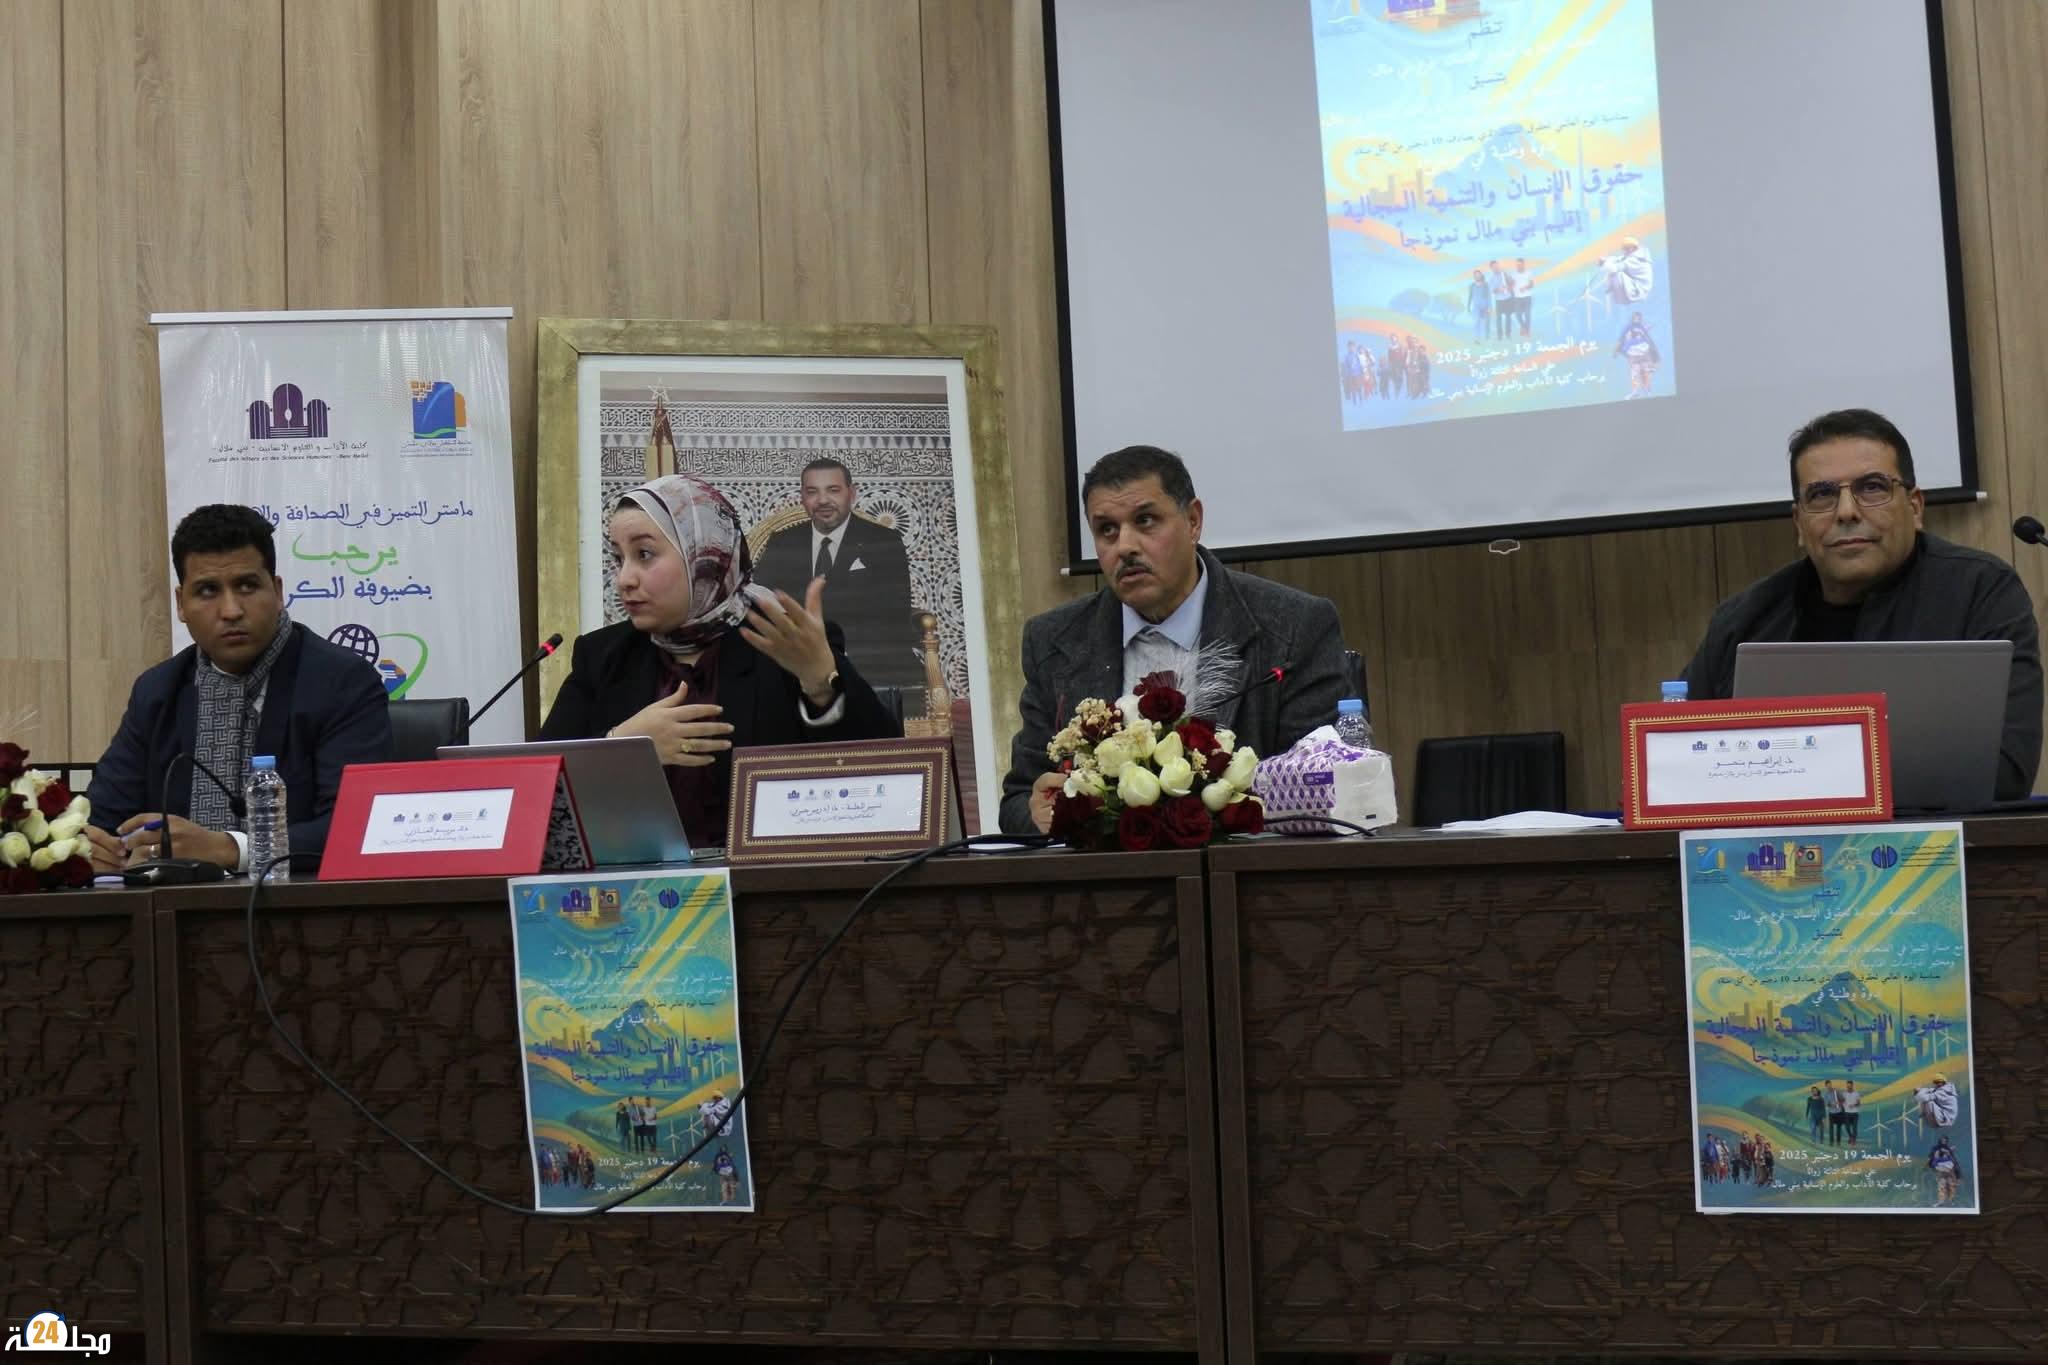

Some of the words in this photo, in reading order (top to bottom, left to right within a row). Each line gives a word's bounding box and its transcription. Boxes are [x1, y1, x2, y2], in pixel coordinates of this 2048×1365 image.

[1507, 168, 1572, 203] الإنسان
[1582, 163, 1643, 195] حقوق
[1426, 181, 1496, 211] والتنمية
[1468, 219, 1502, 242] ملال
[1544, 211, 1583, 243] إقليم
[1435, 349, 1472, 364] 2025
[1515, 342, 1532, 355] 19
[286, 503, 349, 522] الصحافة
[340, 505, 381, 528] في
[375, 501, 427, 526] التميز
[421, 501, 473, 525] ماستر
[292, 533, 399, 575] يرحب
[284, 576, 344, 608] الكر
[354, 575, 432, 605] بضيوفه
[1706, 1016, 1766, 1039] المجالية
[1775, 1015, 1831, 1038] والتنمية
[1840, 1013, 1893, 1039] الإنسان
[1902, 1013, 1952, 1036] حقوق
[687, 1036, 725, 1057] حقوق
[1807, 1046, 1835, 1064] ملال
[598, 1158, 620, 1167] 2025
[1779, 1150, 1809, 1160] 2025
[1843, 1150, 1857, 1160] 19
[1861, 1149, 1892, 1160] الجمعة
[1896, 1151, 1912, 1167] يوم
